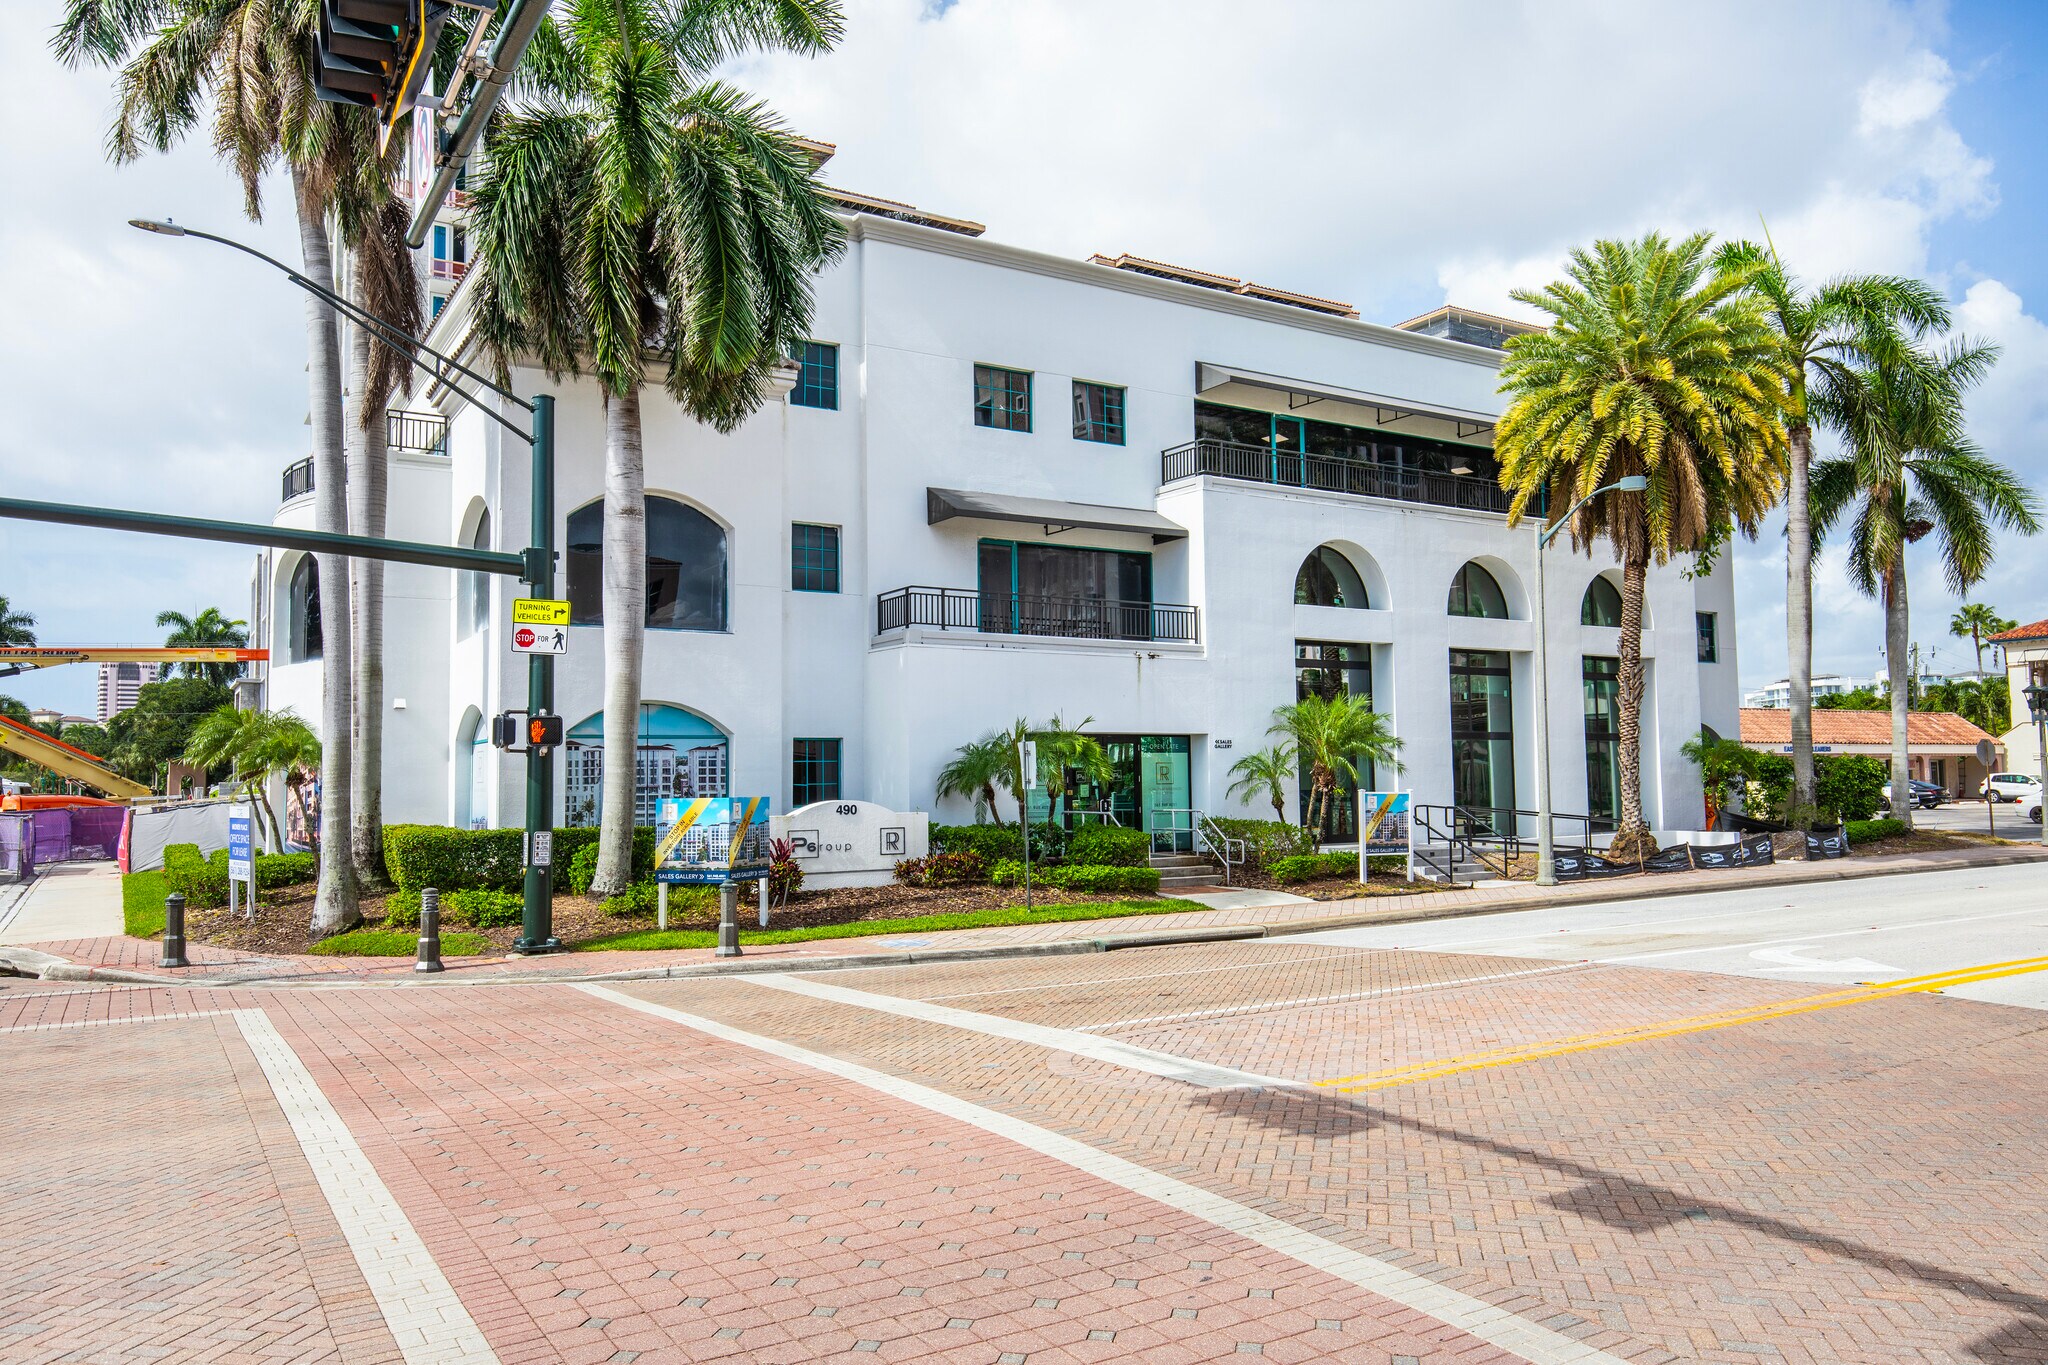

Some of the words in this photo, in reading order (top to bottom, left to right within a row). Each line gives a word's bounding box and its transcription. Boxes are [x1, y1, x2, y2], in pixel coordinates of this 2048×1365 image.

[516, 634, 535, 642] STOP
[836, 804, 857, 815] 490
[663, 832, 682, 855] INVENTORY
[680, 812, 698, 834] AVAILABLE
[668, 825, 681, 839] STOP
